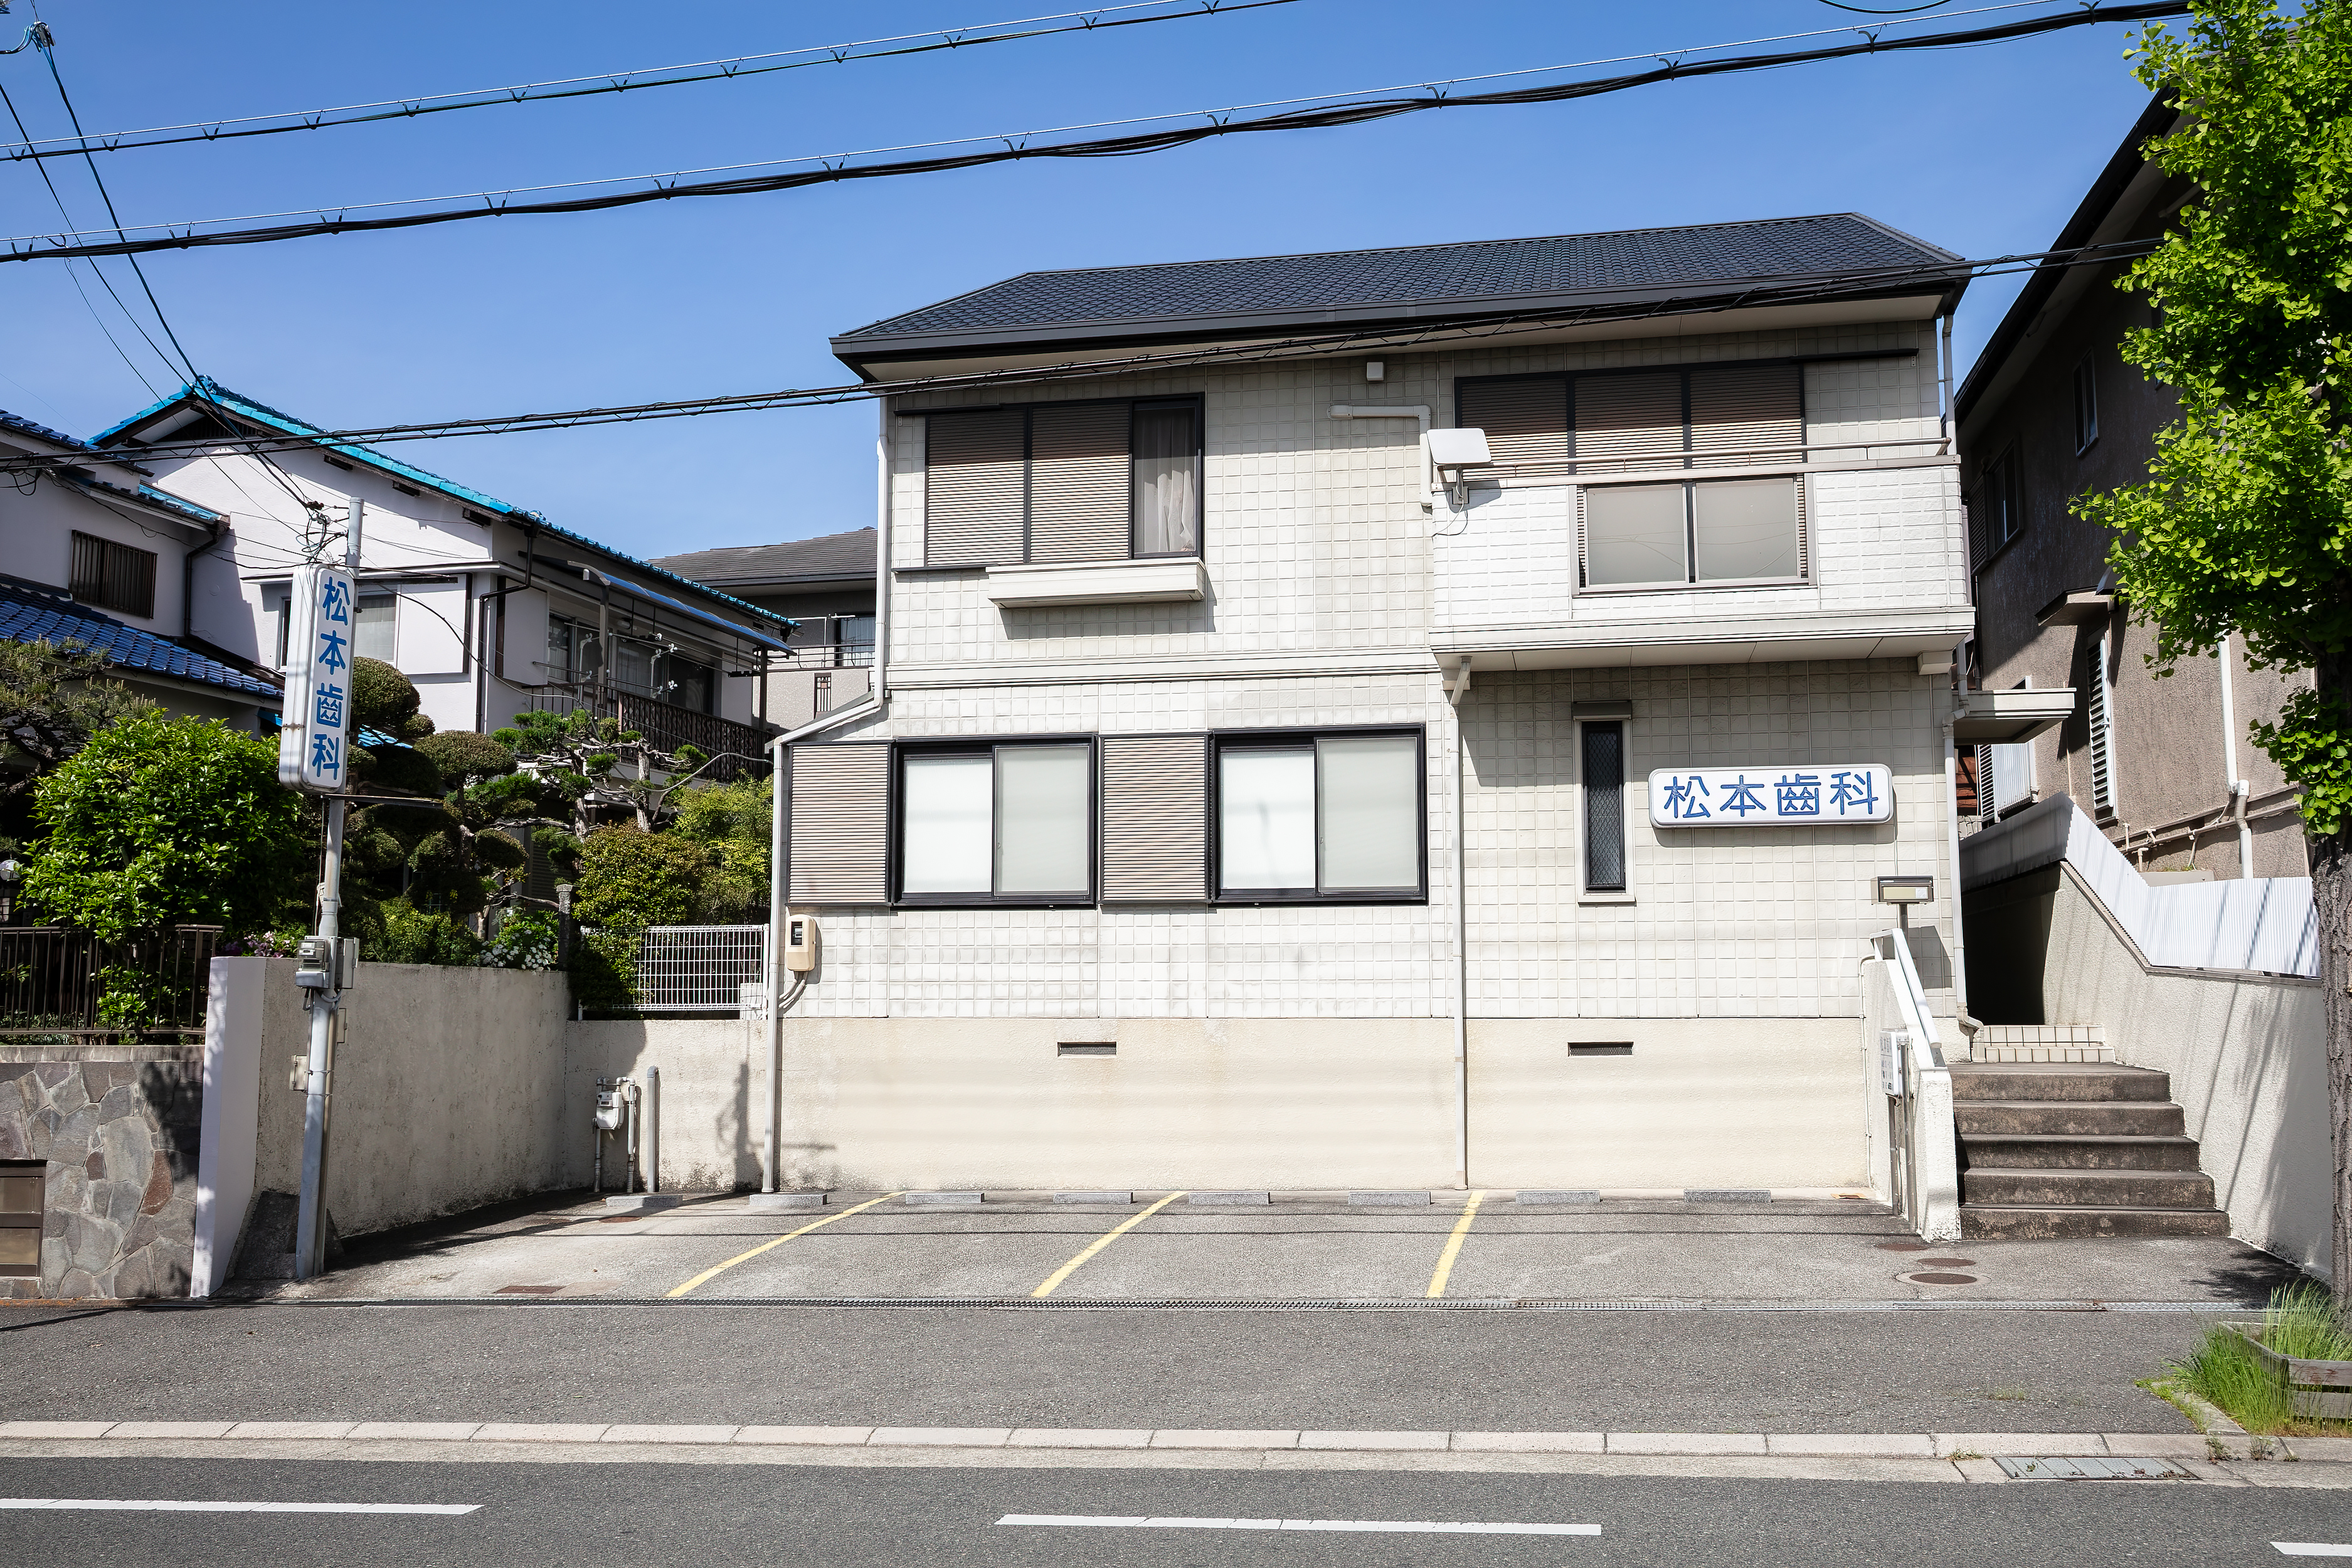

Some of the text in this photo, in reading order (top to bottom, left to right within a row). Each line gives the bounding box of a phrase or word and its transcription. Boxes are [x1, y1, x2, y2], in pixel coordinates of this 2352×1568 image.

[312, 576, 351, 780] 松本齒科
[1663, 771, 1878, 818] 松本齒科
